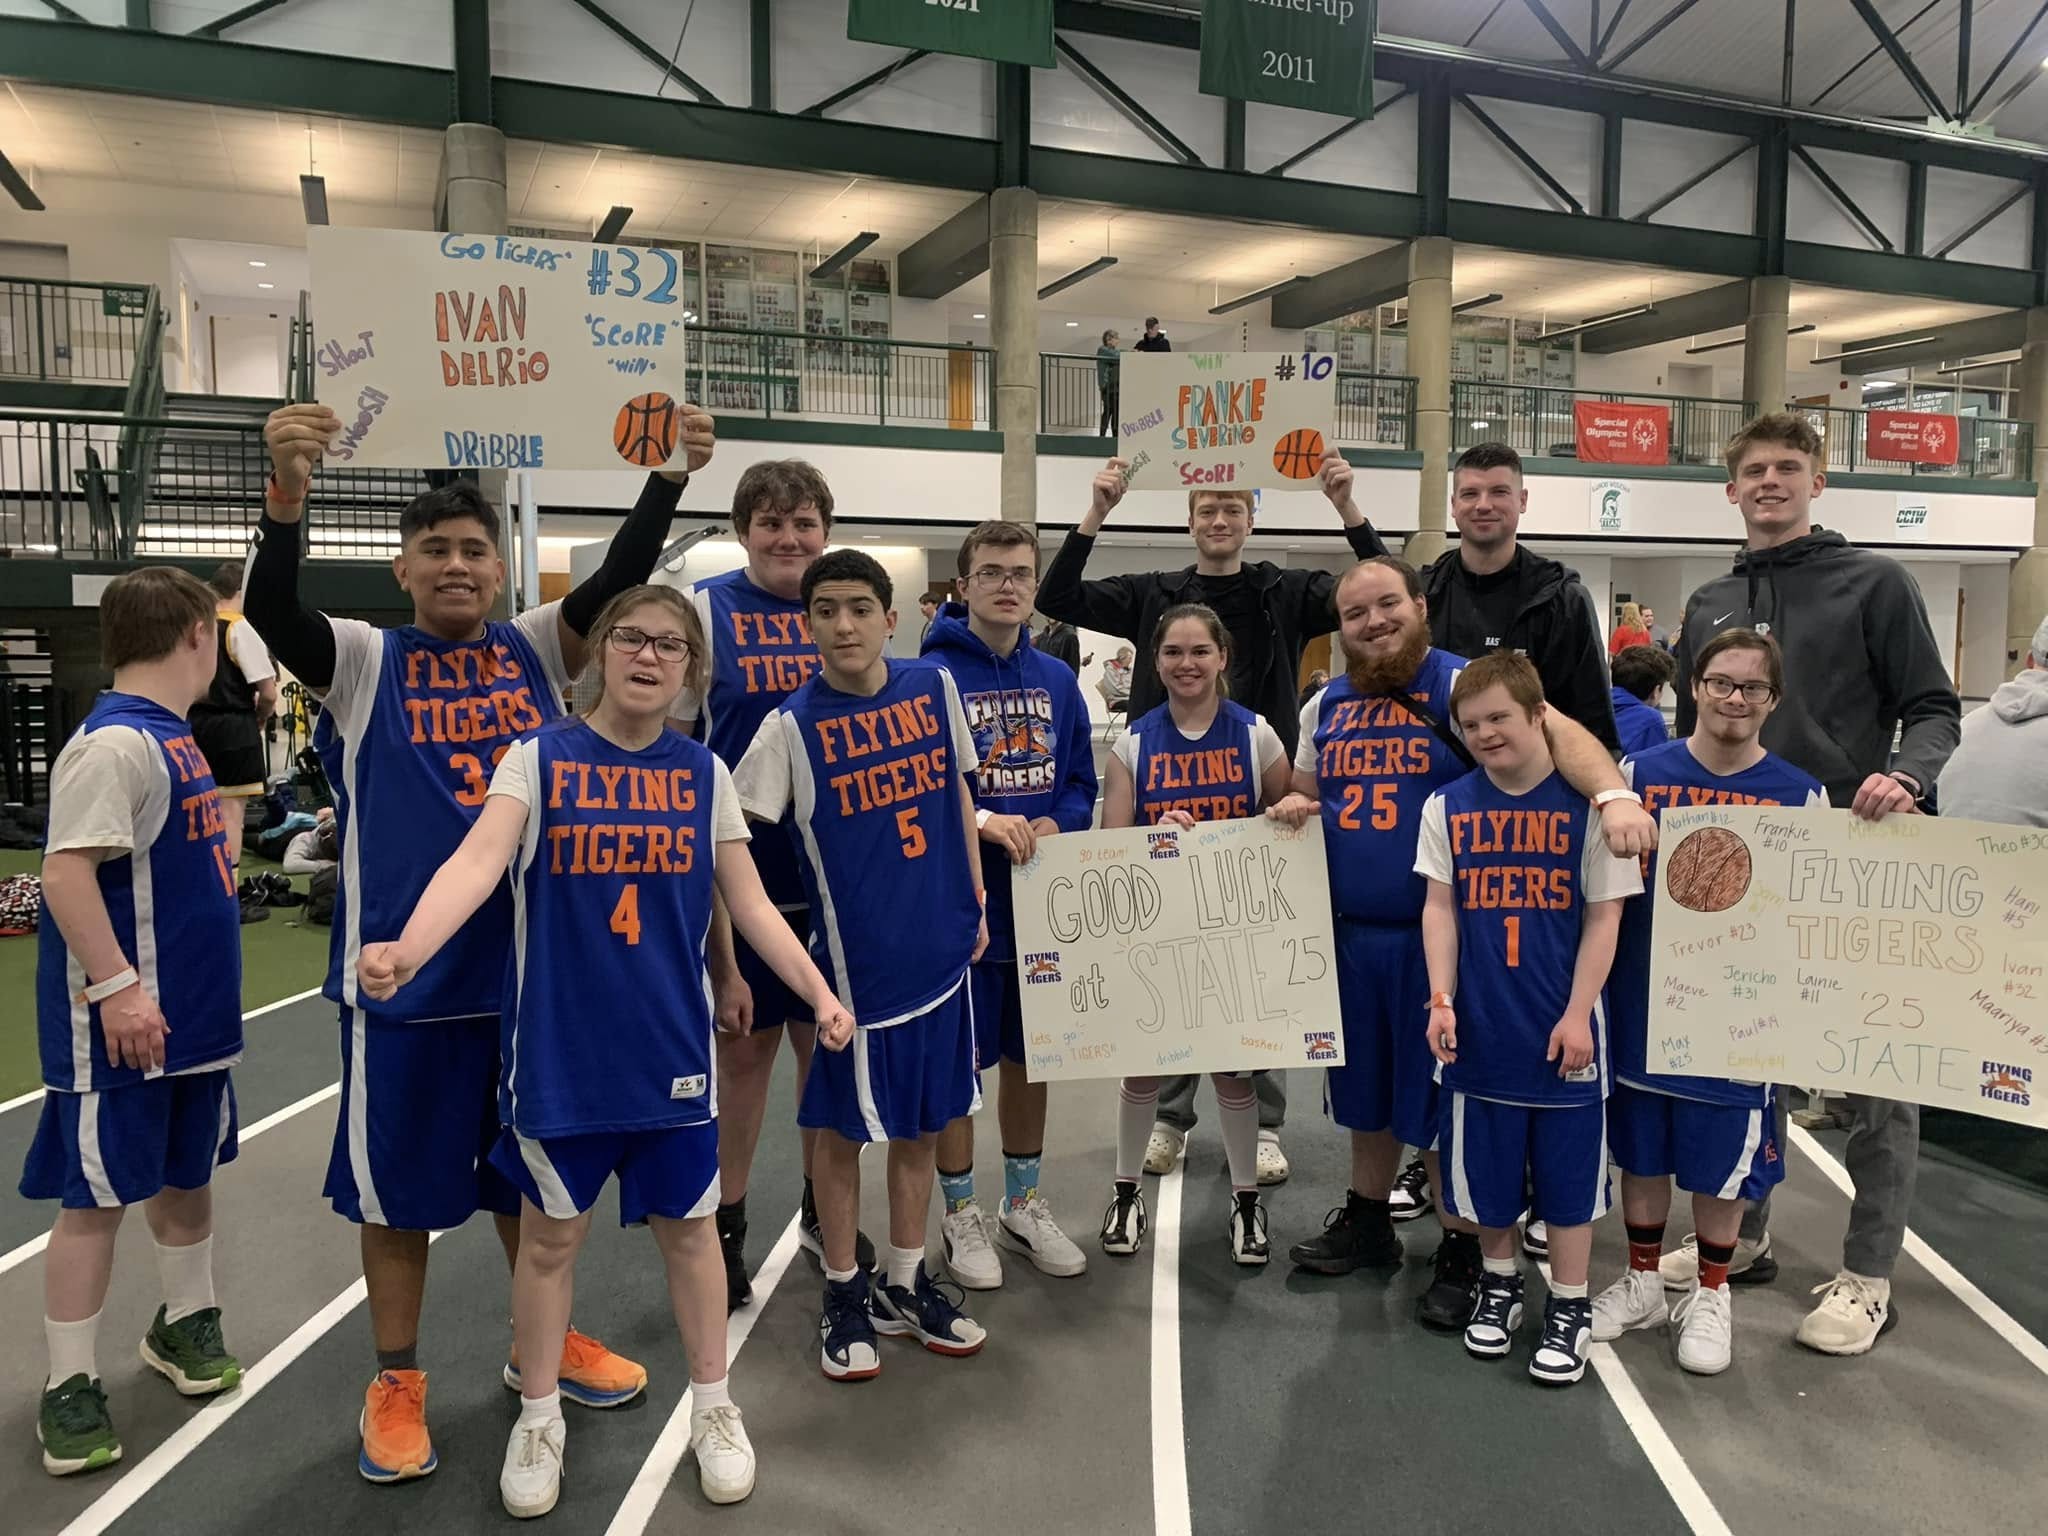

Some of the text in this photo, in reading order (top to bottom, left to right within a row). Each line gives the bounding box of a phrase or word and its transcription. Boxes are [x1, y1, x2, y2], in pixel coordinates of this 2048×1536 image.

[1262, 50, 1316, 83] 2011
[587, 248, 678, 305] #32
[435, 284, 527, 343] IVAN
[1274, 352, 1334, 381] #10
[731, 612, 812, 646] FLYI
[405, 644, 522, 690] FLYING
[738, 653, 826, 693] TIGE
[405, 687, 544, 743] TIGERS
[816, 694, 940, 764] FLYING
[449, 745, 513, 806] 3
[977, 755, 1055, 797] TIGERS
[1145, 747, 1244, 791] FLYING
[1321, 737, 1430, 777] TIGERS
[548, 760, 696, 812] FLYING
[830, 746, 946, 816] TIGERS
[1339, 783, 1397, 830] 25
[896, 806, 927, 859] 5
[1147, 831, 1179, 844] FLYING
[1450, 811, 1571, 856] FLYING
[1754, 815, 1811, 841] Frankie
[1763, 839, 1788, 852] #10
[1976, 836, 2018, 855] Theo
[547, 825, 696, 874] TIGERS
[1149, 849, 1181, 861] TIGERS
[1047, 845, 1296, 943] GOOD LUCK
[1789, 849, 1983, 917] FLYING
[610, 883, 641, 945] 4
[2002, 909, 2033, 929] #5
[1024, 951, 1060, 966] FLYING
[1504, 916, 1520, 967] 1
[1669, 935, 1723, 960] Trevor
[1787, 915, 1984, 974] TIGERS
[1025, 971, 1062, 985] TIGERS
[1071, 963, 1109, 1012] at
[1128, 925, 1288, 1034] STATE
[1663, 976, 1709, 998] Maeve
[1723, 964, 1777, 985] Jericho
[1666, 995, 1688, 1011] #2
[1304, 1031, 1336, 1043] FLYING
[1306, 1049, 1338, 1061] TIGERS
[1816, 1030, 1971, 1092] STATE
[1981, 1060, 2033, 1082] FLYING
[1979, 1084, 2032, 1106] TIGERS
